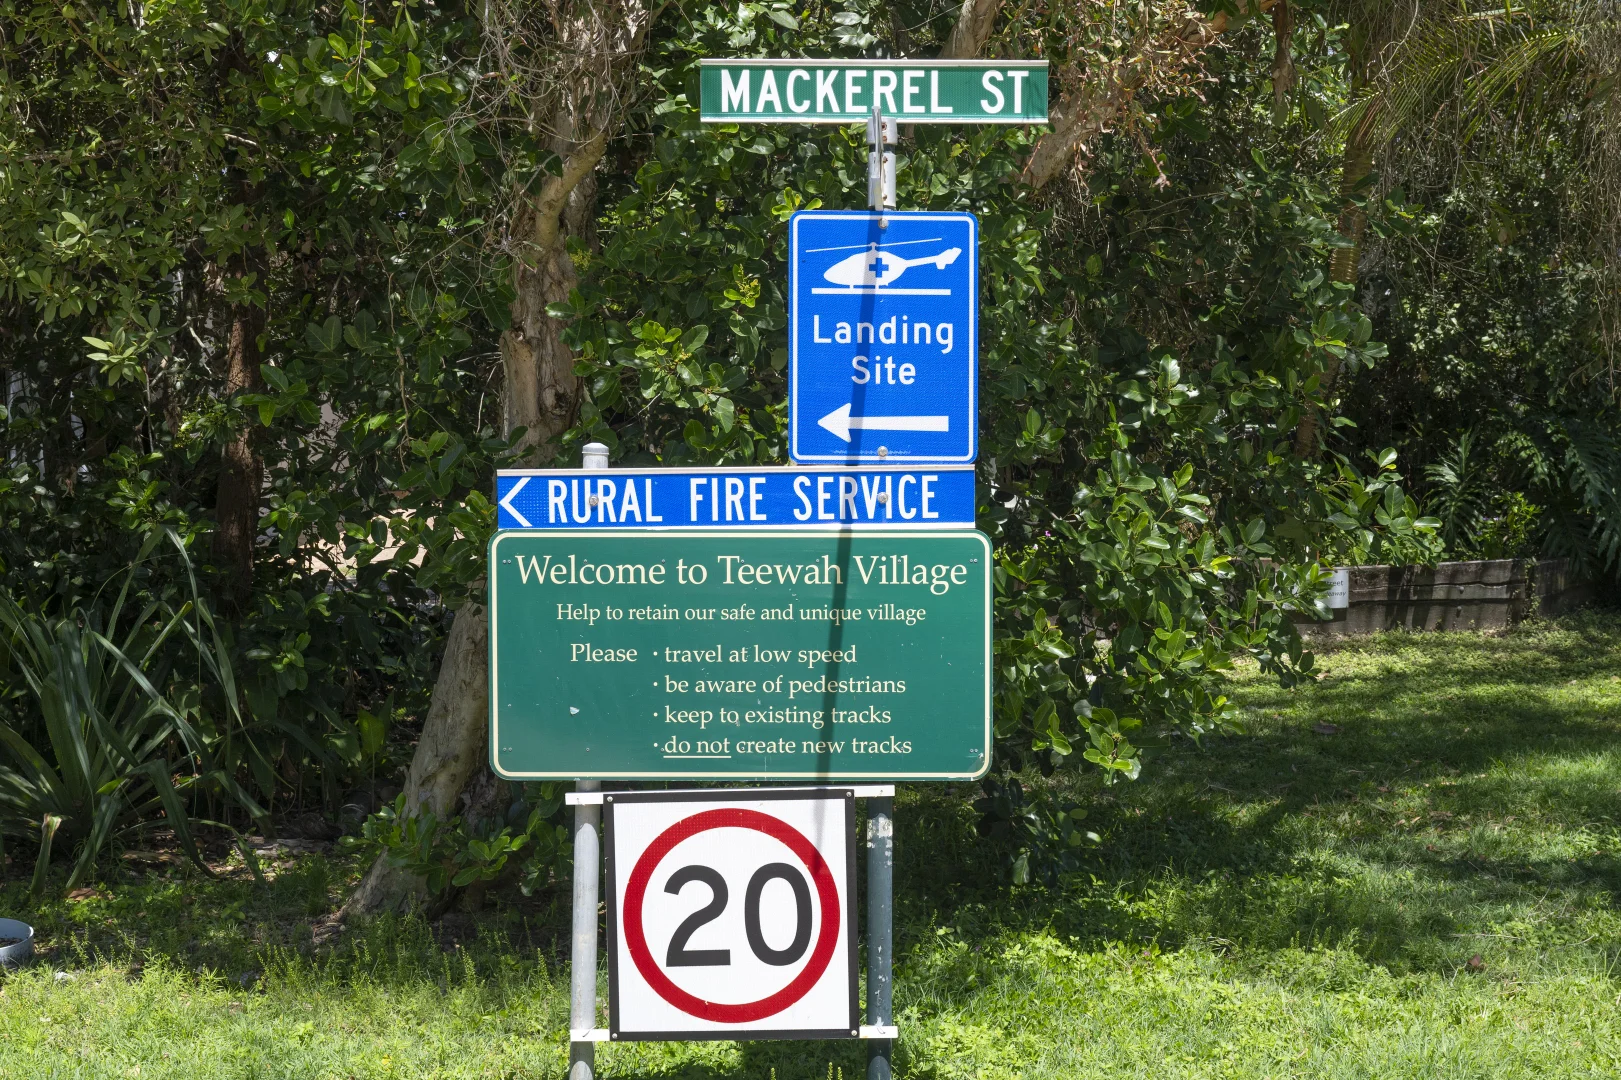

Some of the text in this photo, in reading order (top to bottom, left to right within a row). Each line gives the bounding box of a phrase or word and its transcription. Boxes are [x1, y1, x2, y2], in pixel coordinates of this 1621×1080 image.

[721, 70, 1029, 114] MACKEREL ST
[814, 315, 953, 354] Landing
[852, 356, 916, 384] Site
[548, 475, 939, 524] RURAL FIRE SERVICE
[515, 555, 967, 595] Welcome to Teewah Village
[557, 604, 926, 625] Help to retain our safe and unique village
[571, 643, 856, 668] Please travel at low speed
[665, 675, 905, 698] be aware of pedestrians
[665, 705, 891, 729] keep to existing tracks
[664, 736, 911, 755] do not create new tracks
[664, 862, 812, 967] 20
